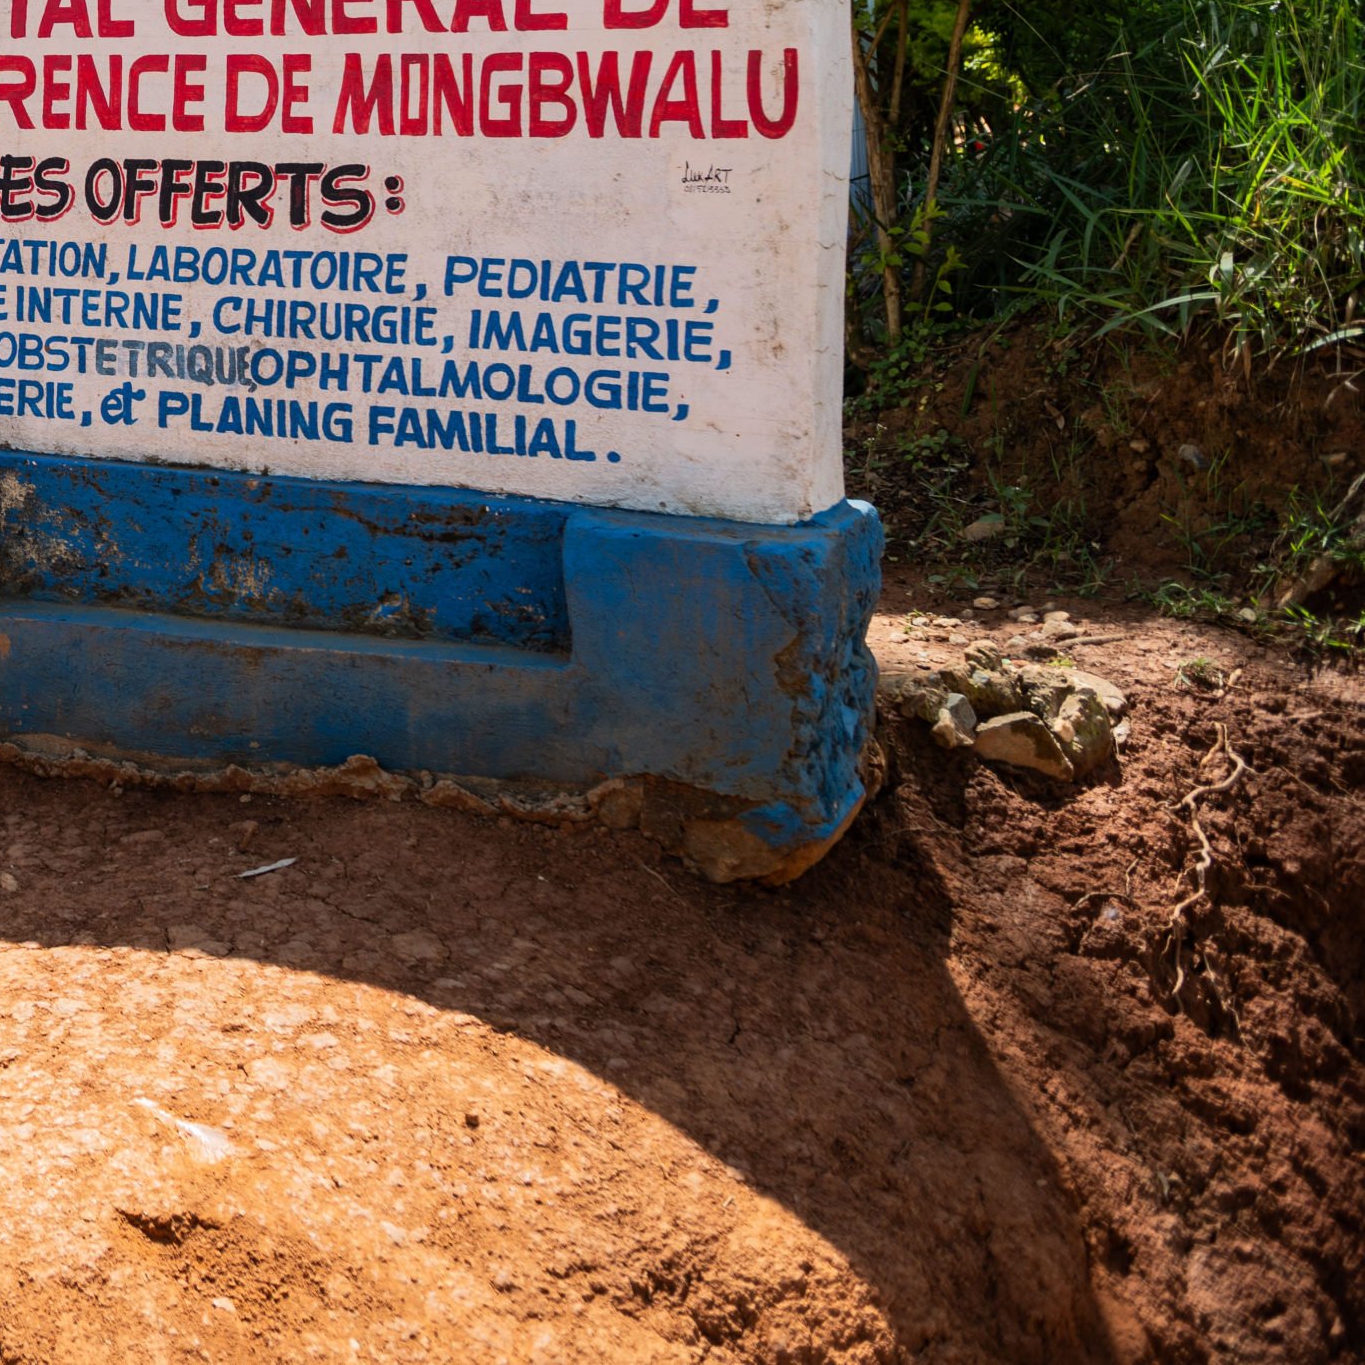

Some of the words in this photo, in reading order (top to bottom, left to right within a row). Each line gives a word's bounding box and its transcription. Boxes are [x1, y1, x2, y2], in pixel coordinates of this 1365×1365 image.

[224, 54, 314, 135] DE
[333, 48, 799, 139] MONGBWALU
[127, 244, 427, 302] LABORATOIRE,
[444, 255, 720, 315] PEDIATRIE,
[16, 285, 201, 338] INTERNE,
[213, 296, 454, 354] CHIRURGIE,
[469, 309, 732, 371] IMAGERIE,
[100, 381, 146, 426] et
[157, 391, 353, 443] PLANING
[368, 405, 622, 463] FAMILIAL.
[250, 348, 690, 422] OPHTALMOLOGIE,
